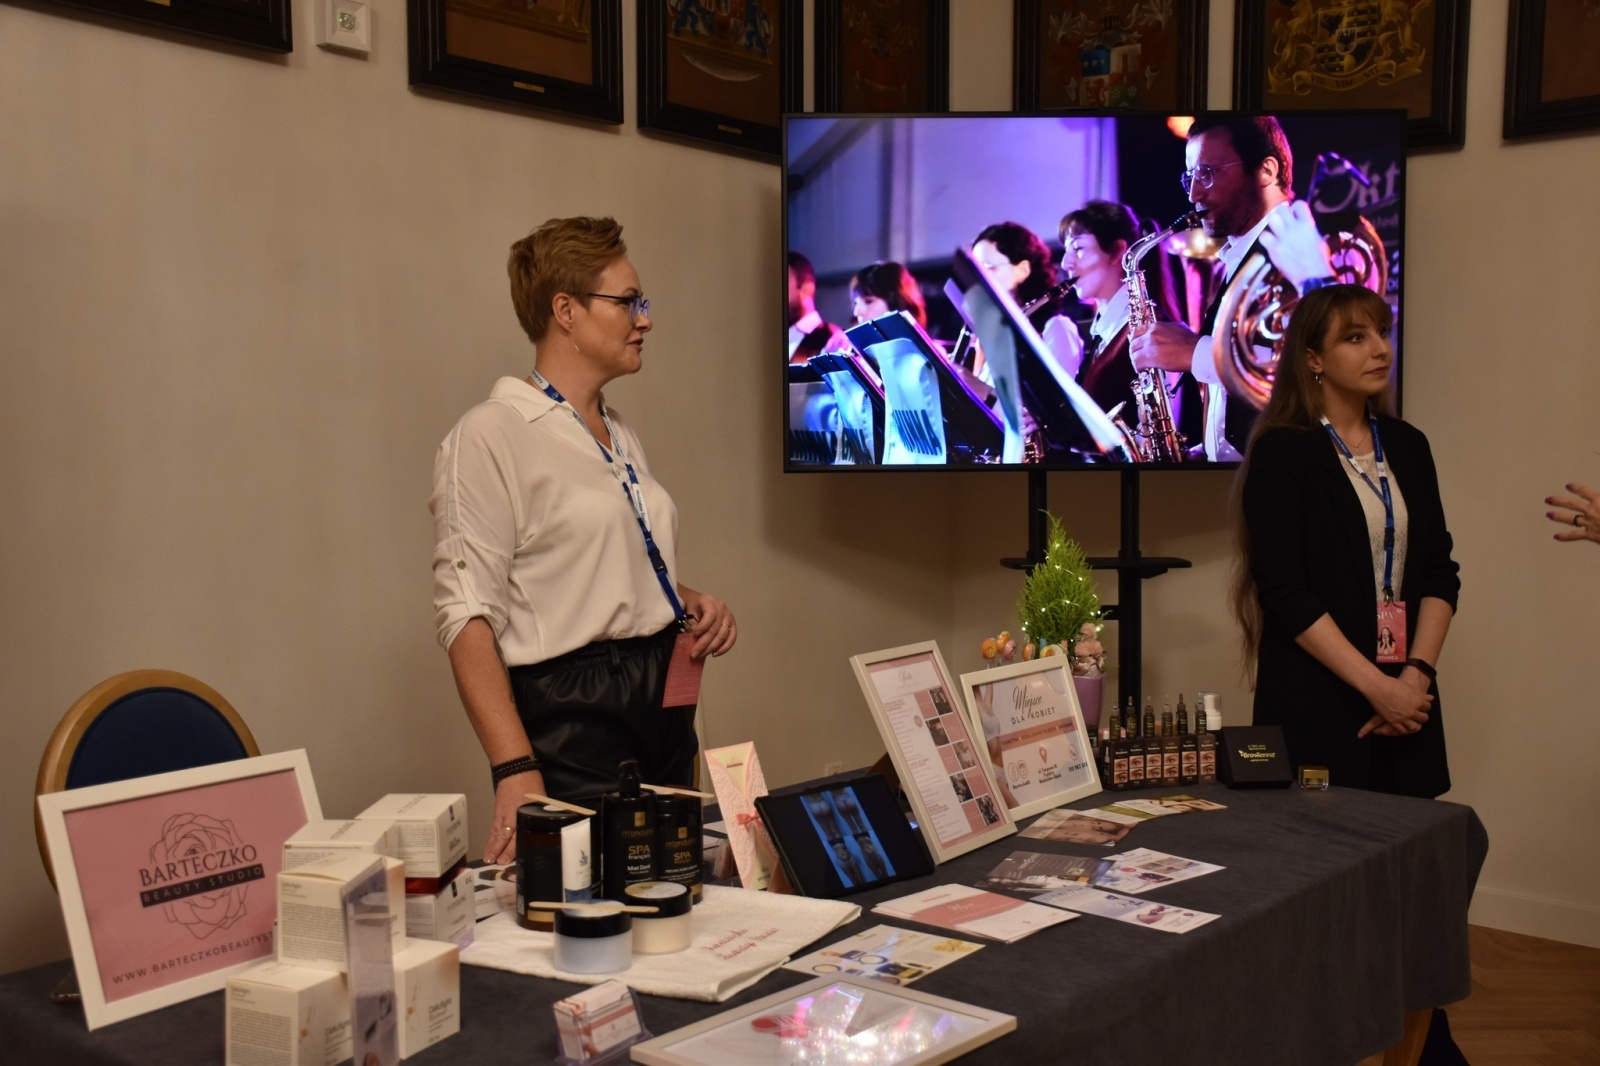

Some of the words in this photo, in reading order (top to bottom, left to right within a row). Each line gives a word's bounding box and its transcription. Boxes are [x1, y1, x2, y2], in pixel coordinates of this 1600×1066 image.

[1012, 685, 1043, 719] Miejsce
[1011, 716, 1026, 725] DLA
[1031, 706, 1056, 719] KOBIET
[628, 844, 651, 855] SPA
[674, 851, 691, 860] SPA
[139, 844, 257, 887] BARTECZKO
[144, 881, 201, 903] BEAUTY
[209, 866, 262, 887] STUDIO
